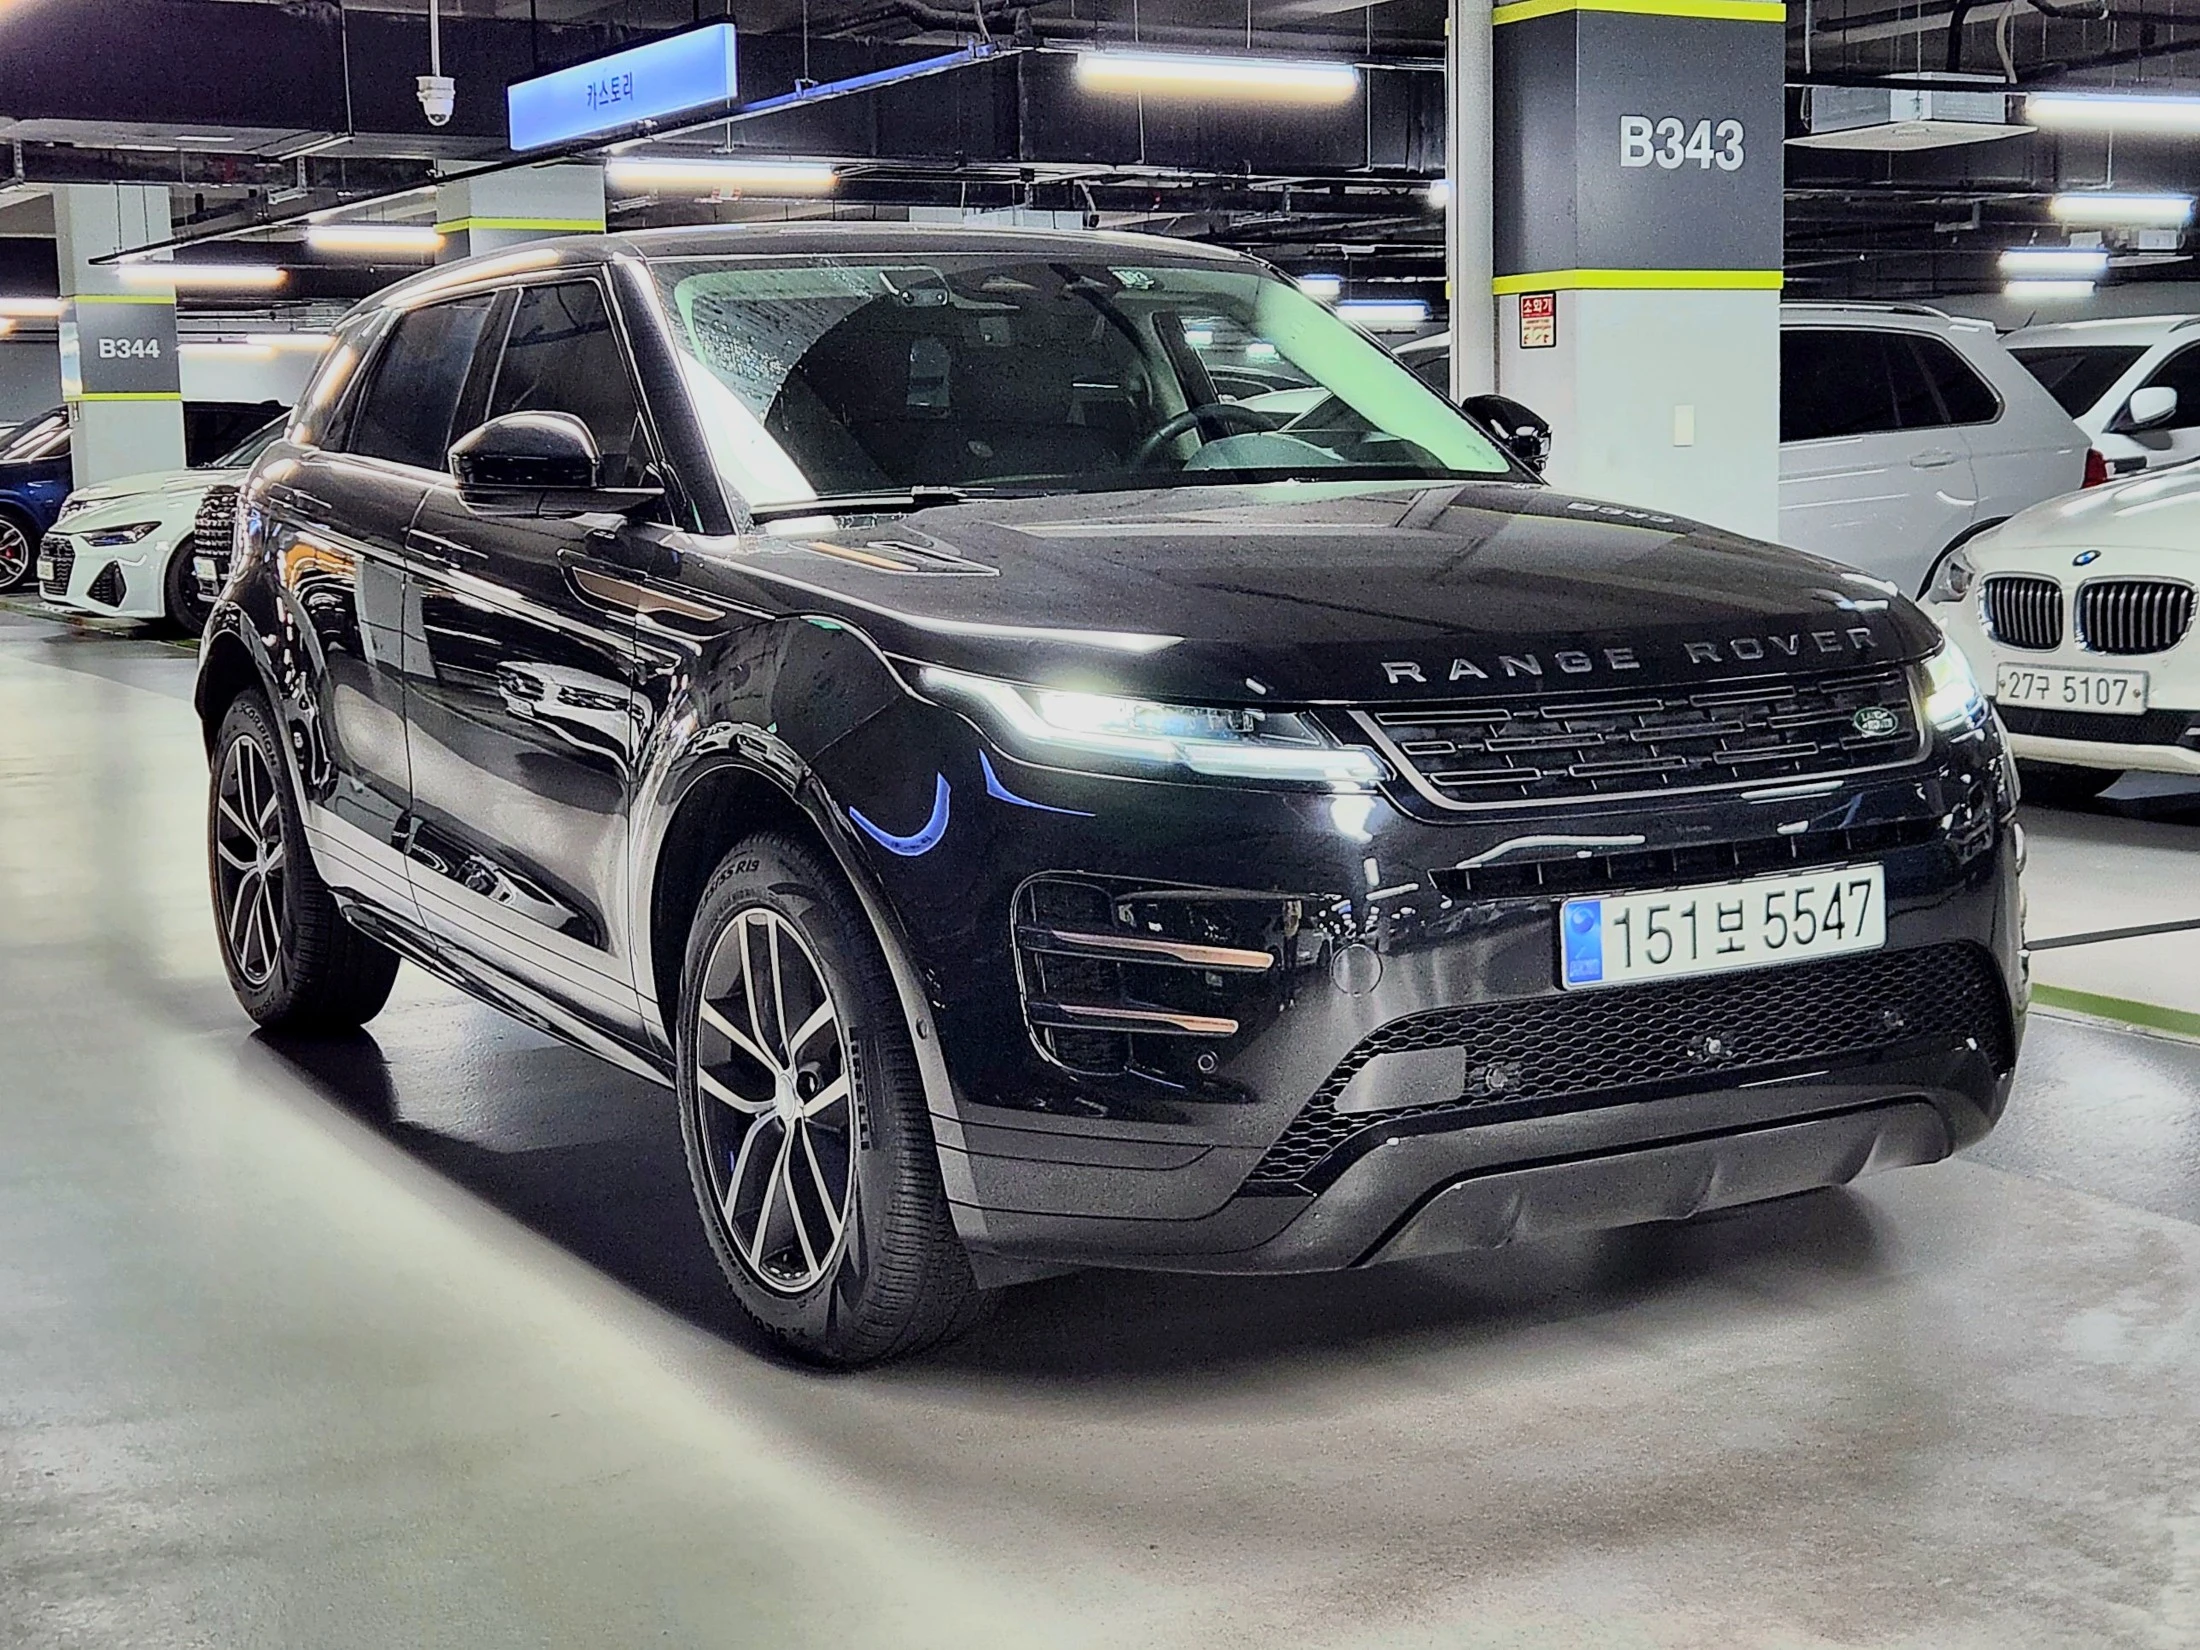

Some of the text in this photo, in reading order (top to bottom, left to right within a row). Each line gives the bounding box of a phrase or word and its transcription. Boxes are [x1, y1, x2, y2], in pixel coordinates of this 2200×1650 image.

[586, 71, 634, 111] 카스토리
[1619, 114, 1745, 172] B343
[1523, 298, 1553, 313] 소화기
[98, 337, 161, 359] B344
[1380, 626, 1878, 684] RANGE ROVER
[2008, 671, 2129, 707] 27구 5107
[1613, 878, 1872, 969] 151보 5547
